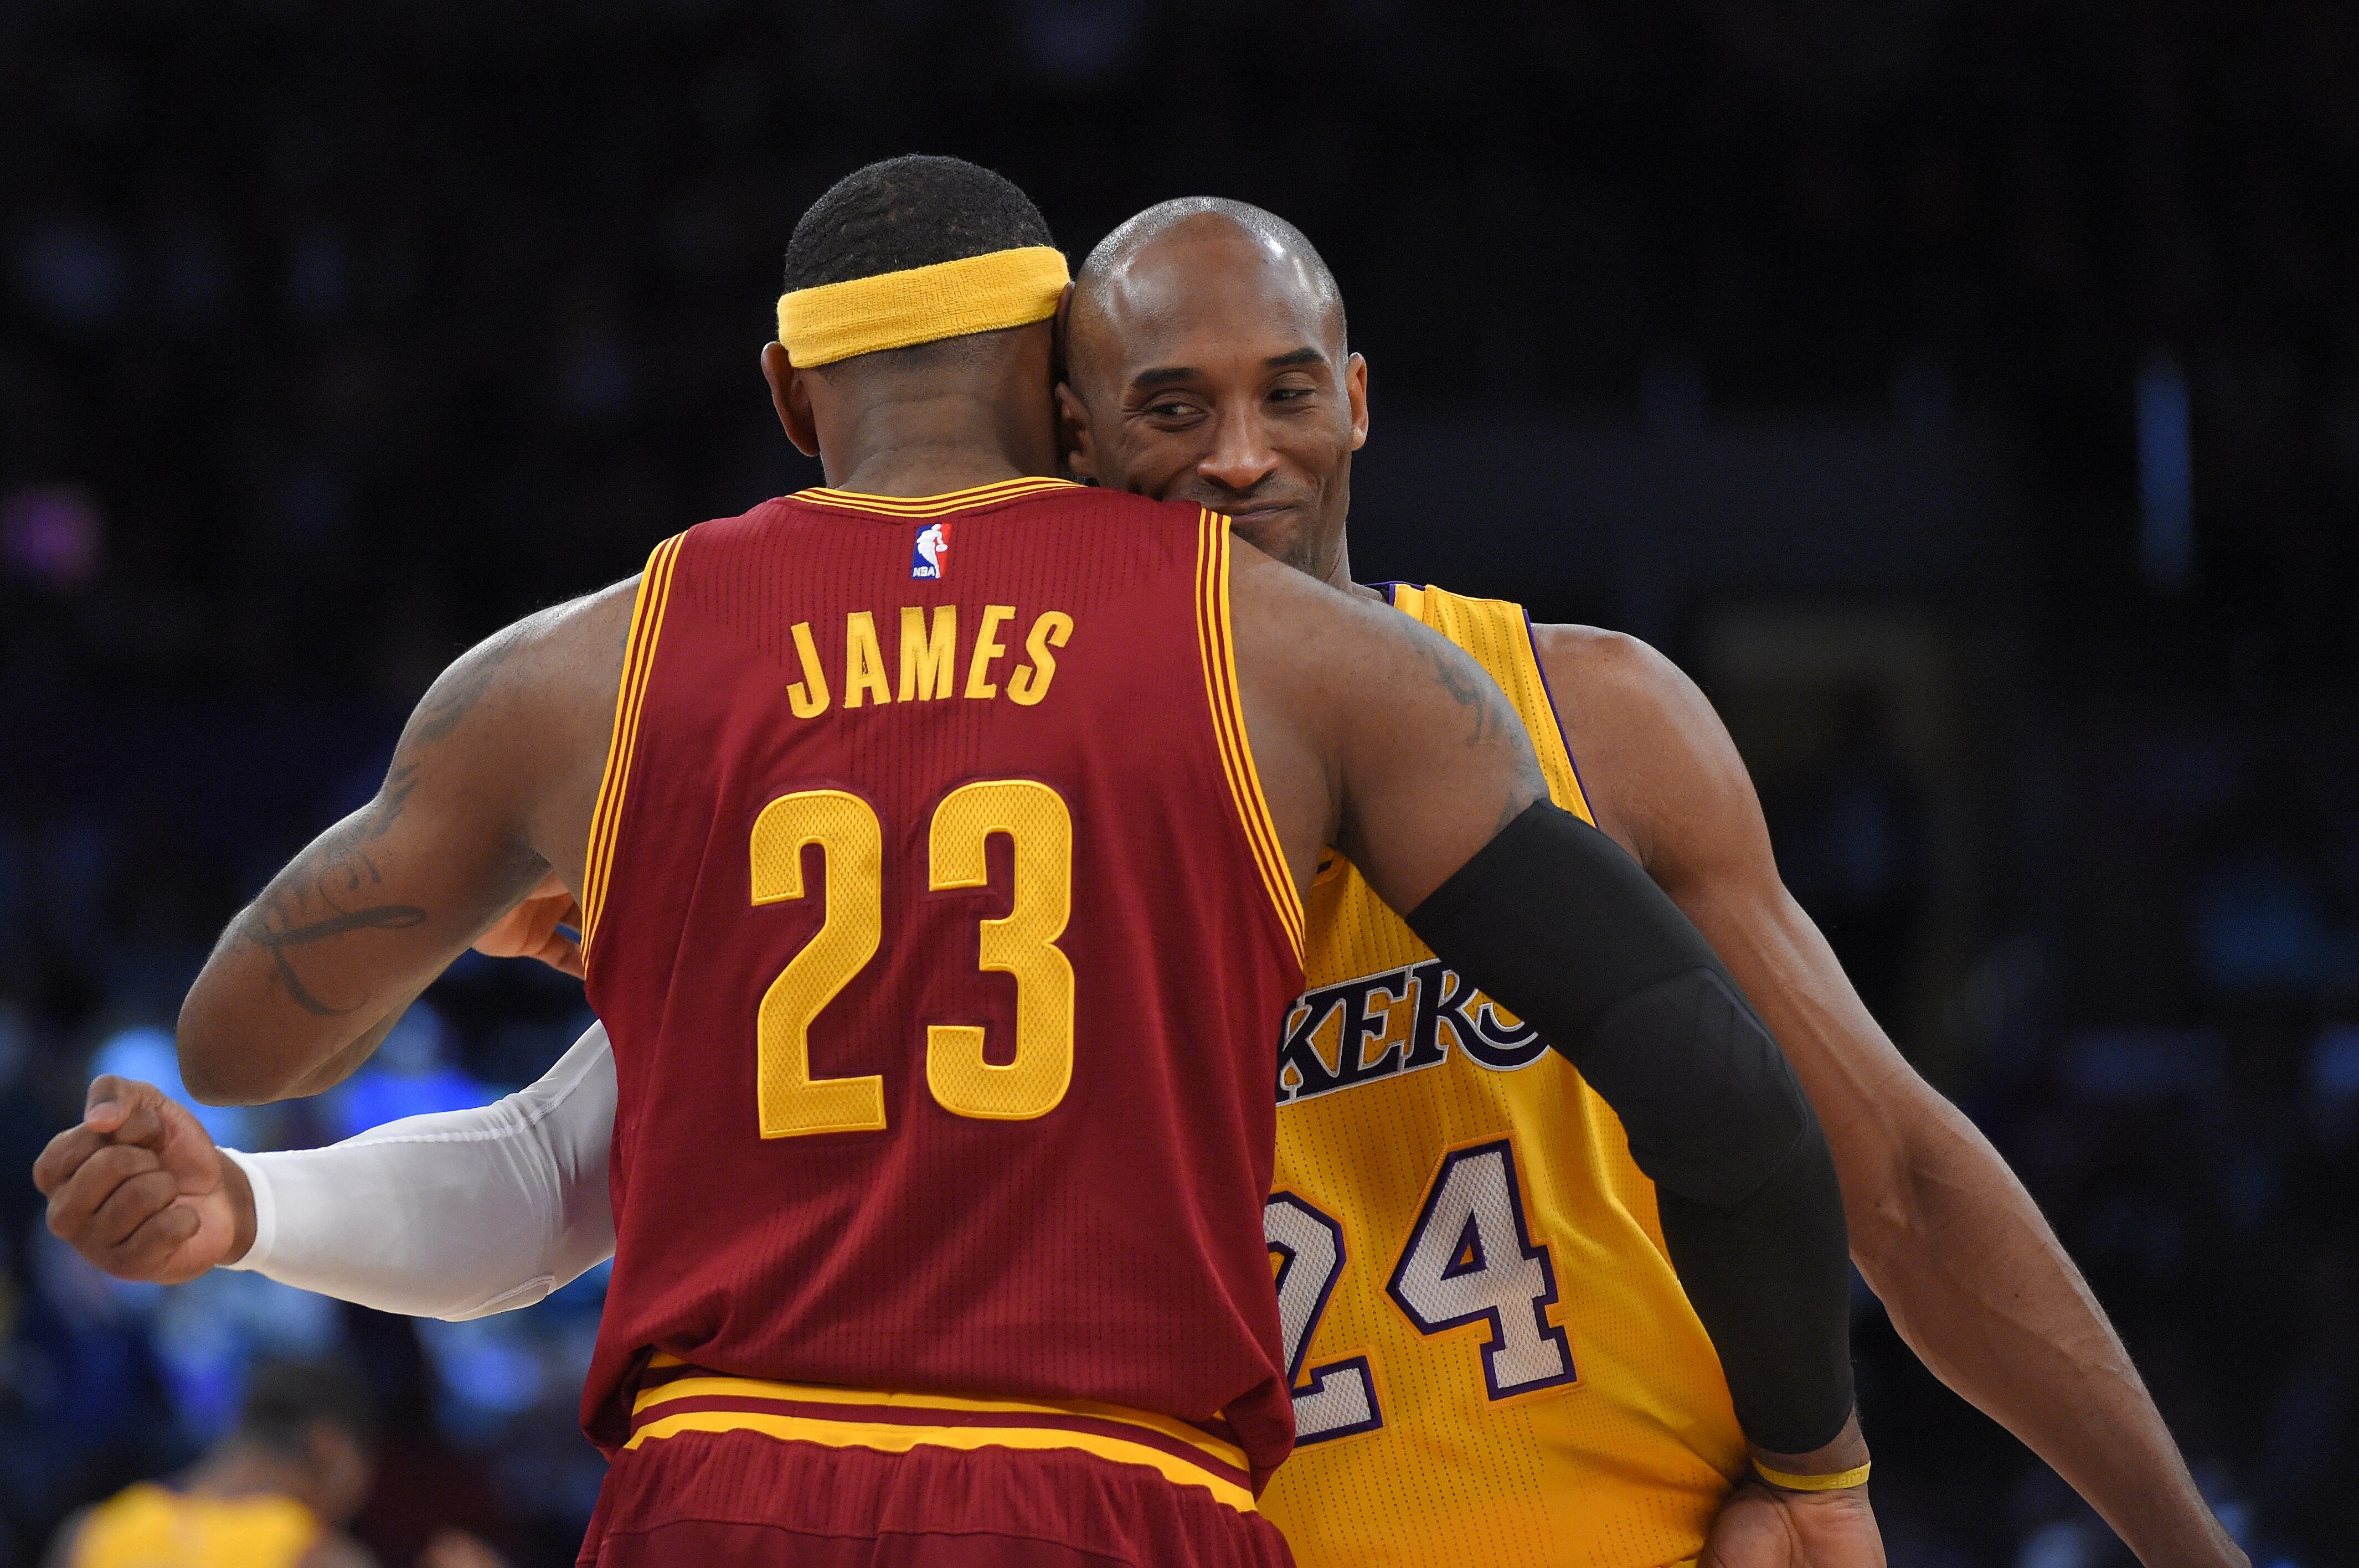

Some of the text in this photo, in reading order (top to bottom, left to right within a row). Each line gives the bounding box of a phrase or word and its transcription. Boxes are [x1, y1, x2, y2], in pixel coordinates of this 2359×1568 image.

[786, 605, 1074, 719] JAMES
[913, 566, 935, 577] NBA
[750, 780, 1075, 1139] 23
[1263, 1138, 1577, 1448] 24
